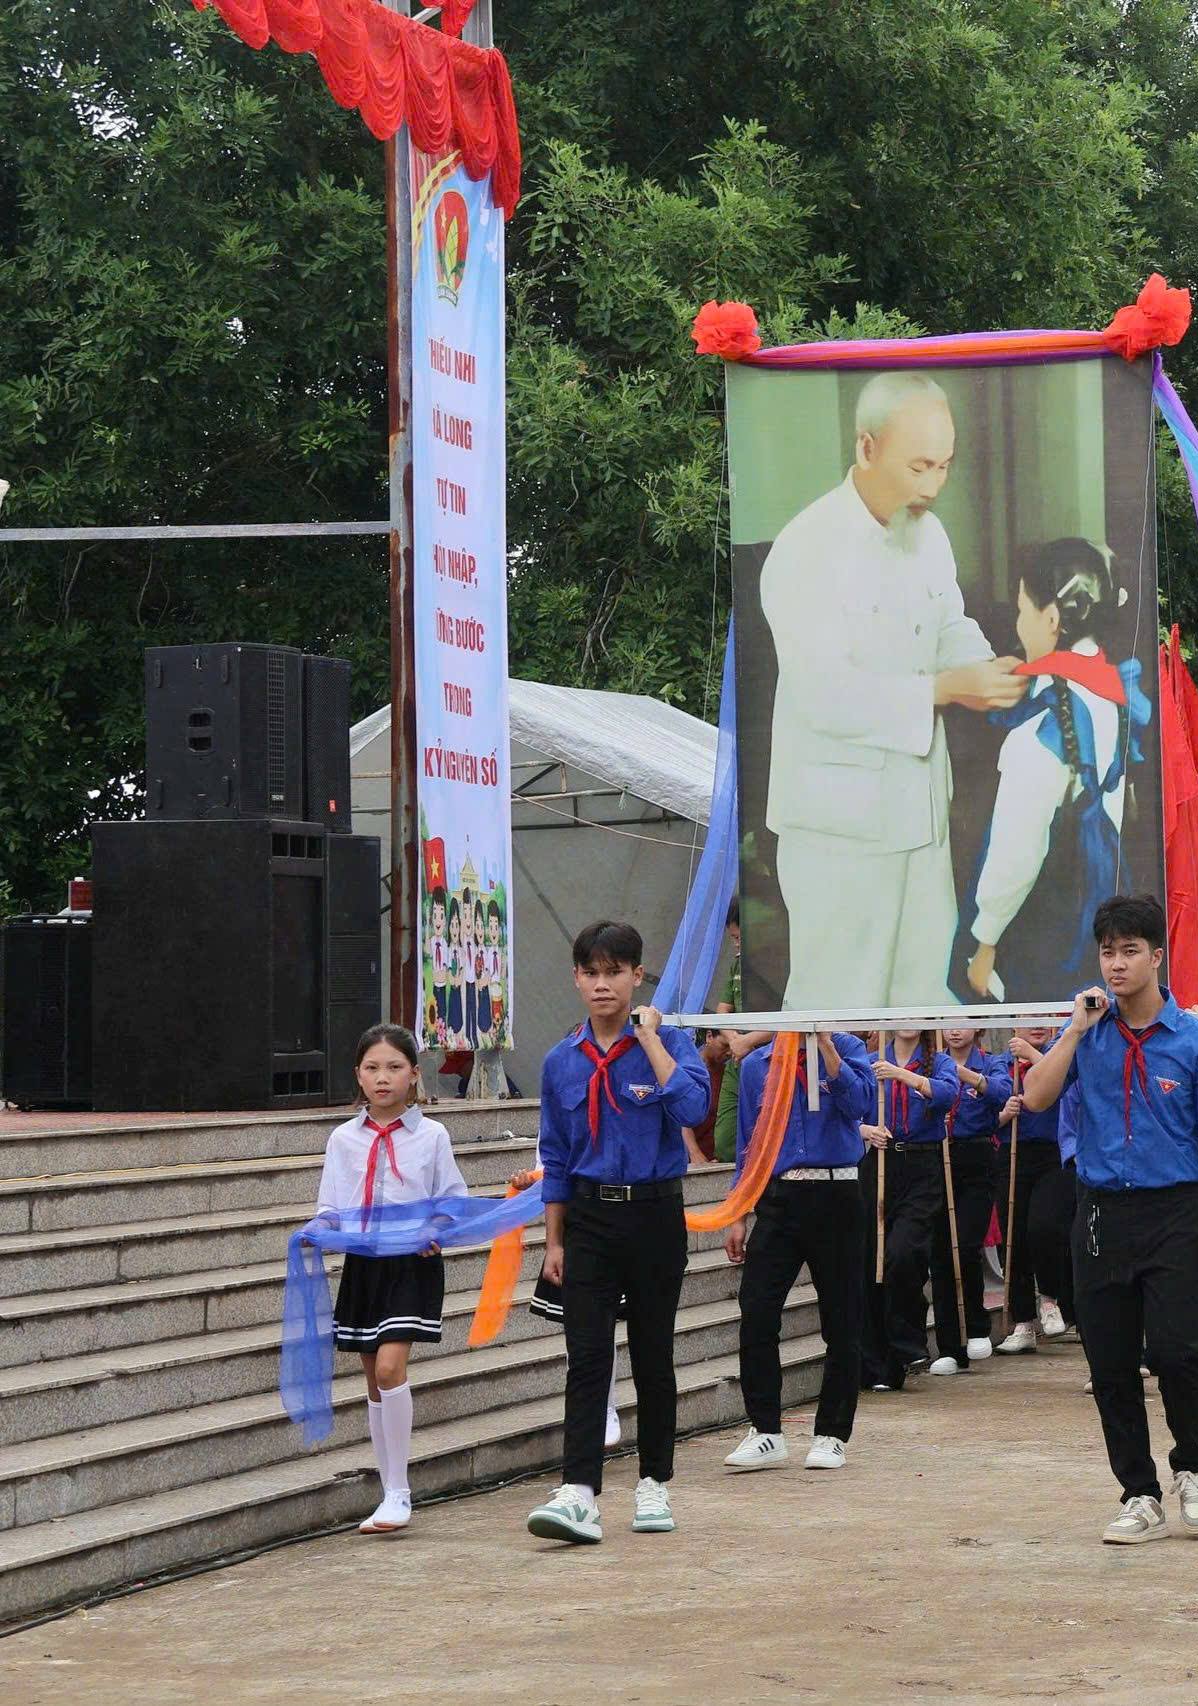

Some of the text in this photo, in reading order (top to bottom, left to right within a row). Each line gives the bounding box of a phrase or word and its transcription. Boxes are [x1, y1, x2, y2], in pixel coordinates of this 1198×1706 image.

[428, 336, 476, 385] HIẾU NHI
[444, 413, 472, 450] LONG
[436, 477, 466, 516] TỰ TIN
[448, 547, 478, 589] NHẬP,
[436, 607, 485, 653] ỪNG BƯỚC
[424, 737, 442, 778] KỶ
[480, 747, 498, 787] SỐ
